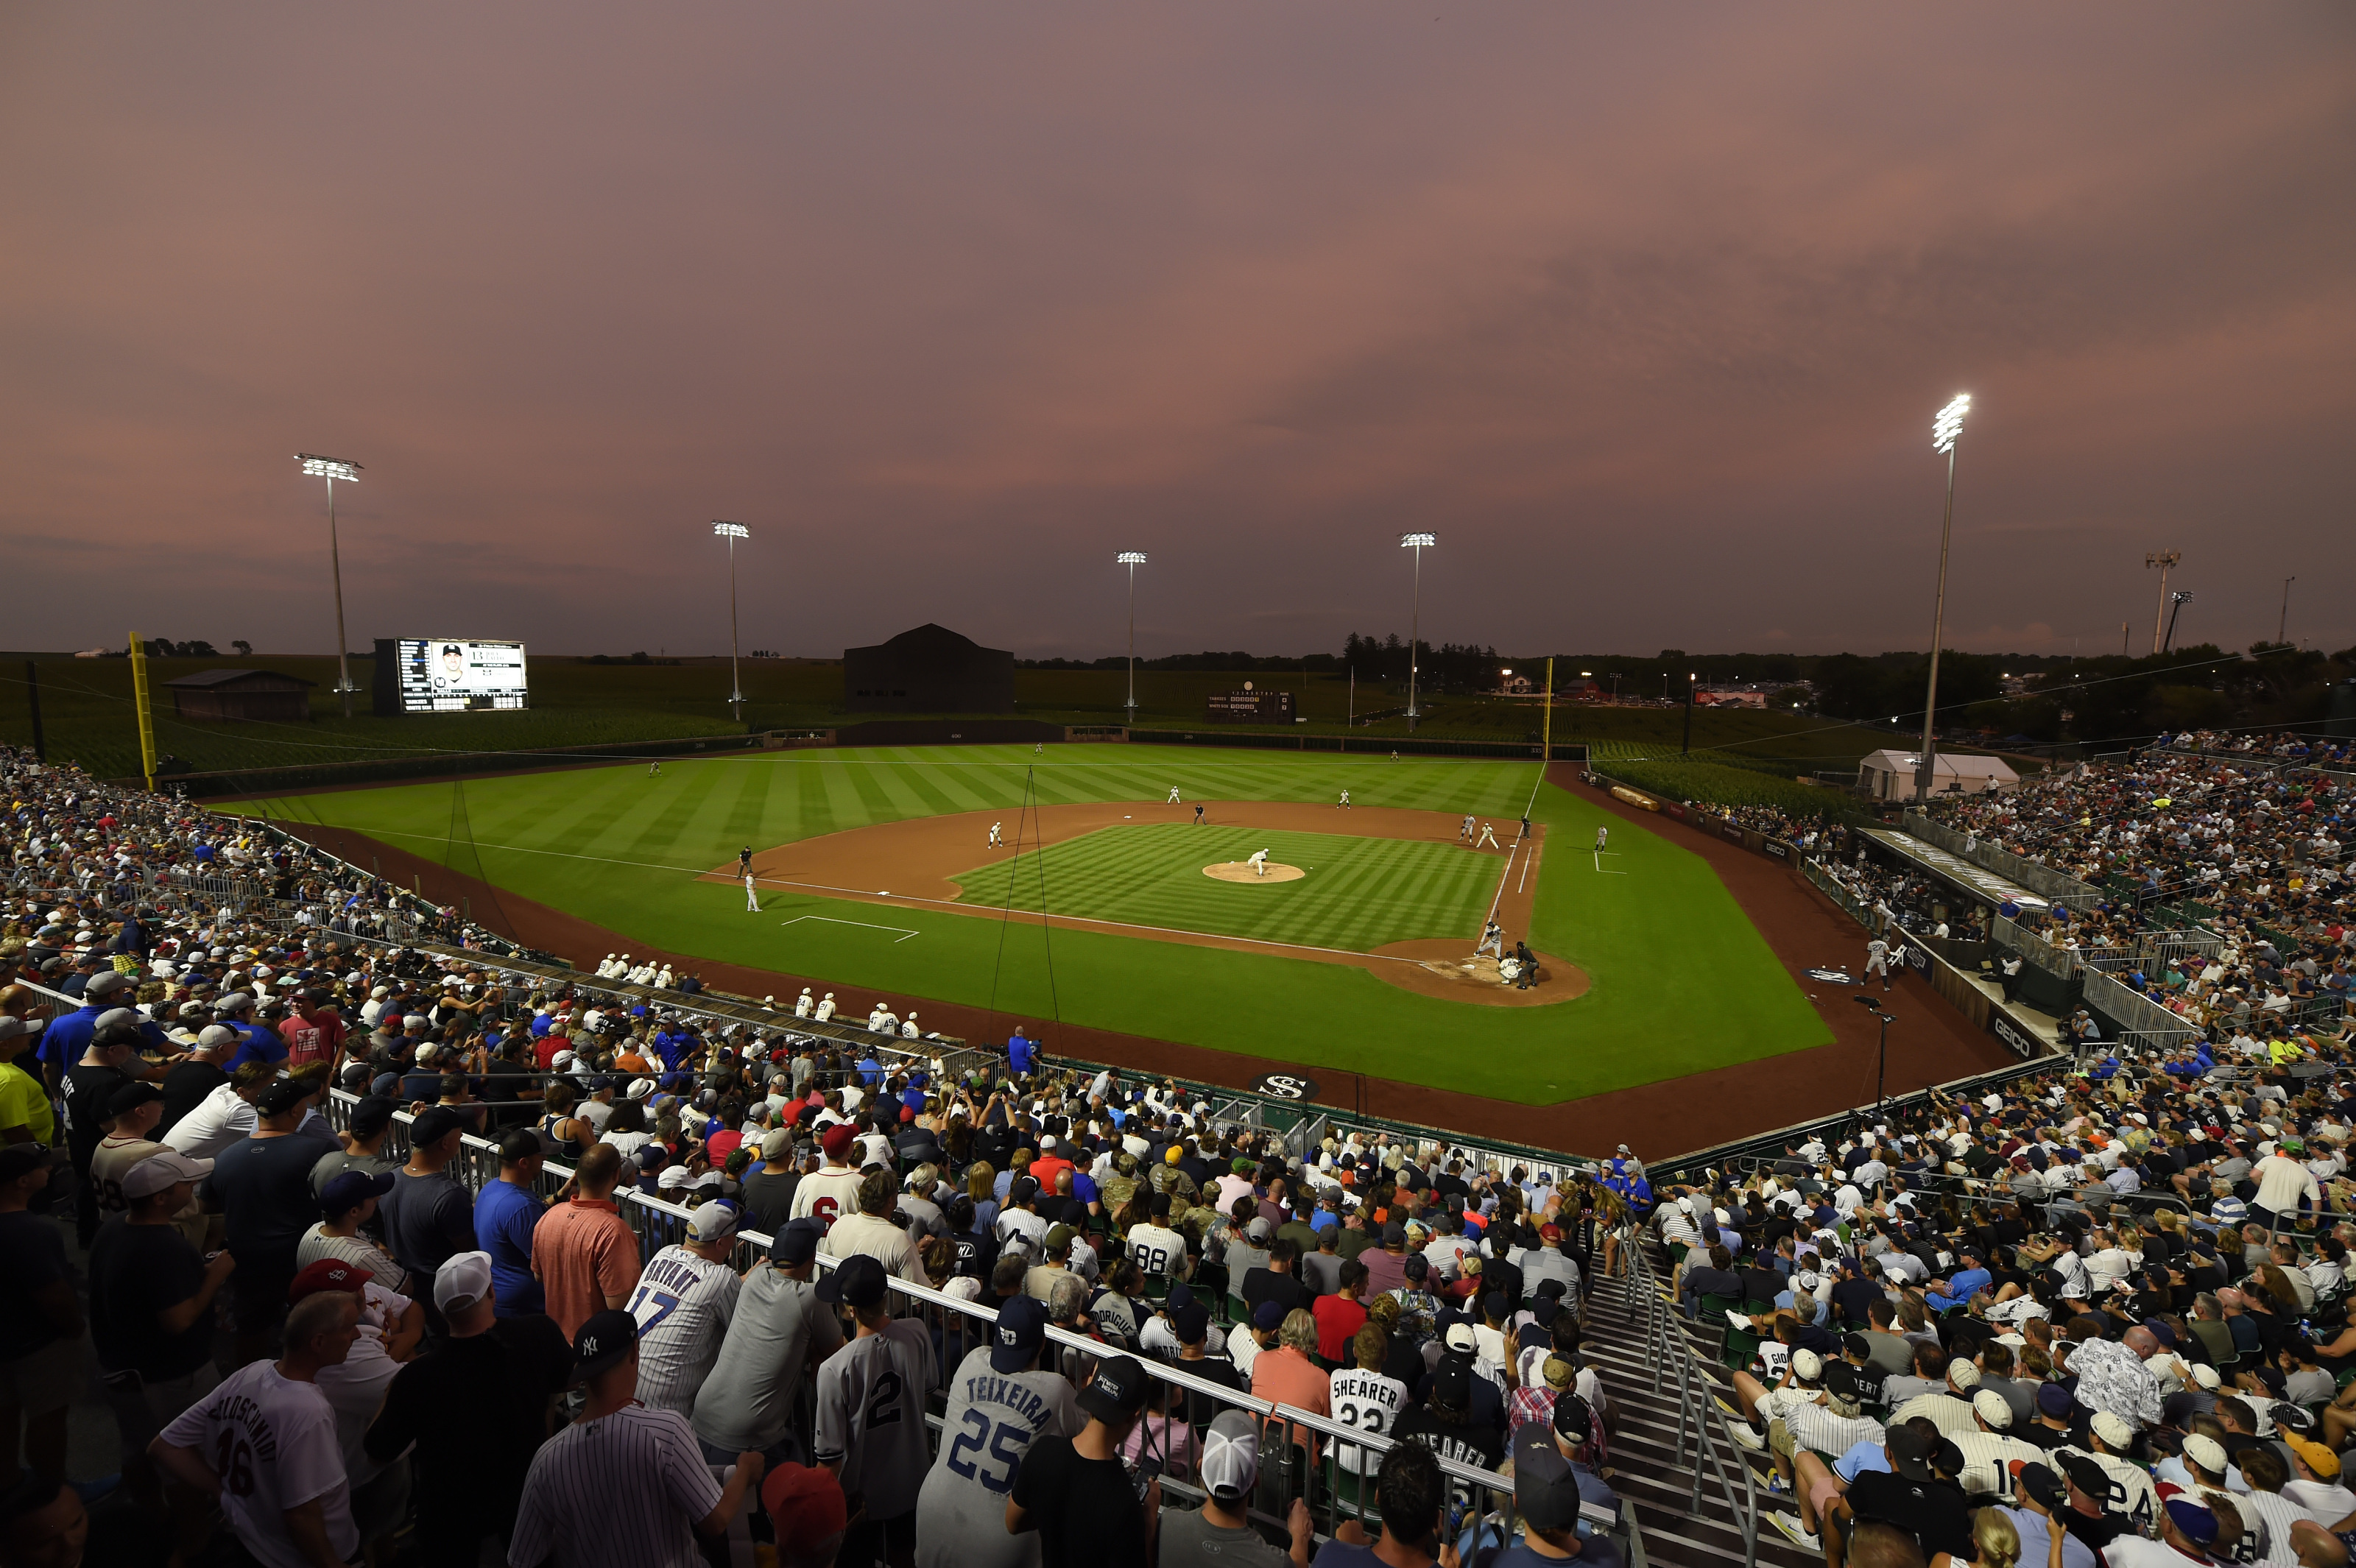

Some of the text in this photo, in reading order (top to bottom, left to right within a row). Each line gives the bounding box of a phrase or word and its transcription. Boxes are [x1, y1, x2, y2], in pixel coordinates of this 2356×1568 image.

[165, 782, 188, 792] 335
[1766, 843, 1785, 857] GEICO
[870, 1016, 878, 1025] 47
[885, 1018, 893, 1027] 49
[1995, 1018, 2030, 1057] GEICO
[1817, 1153, 1830, 1163] 25
[1135, 1244, 1168, 1274] 88
[646, 1259, 701, 1298] BRYANT
[631, 1286, 683, 1338] 17
[583, 1337, 598, 1356] NY
[866, 1371, 903, 1430] 2
[966, 1377, 1052, 1434] TEIXEIRA
[1334, 1380, 1397, 1409] SHEARER
[947, 1408, 1031, 1494] 25
[2101, 1479, 2154, 1525] 24
